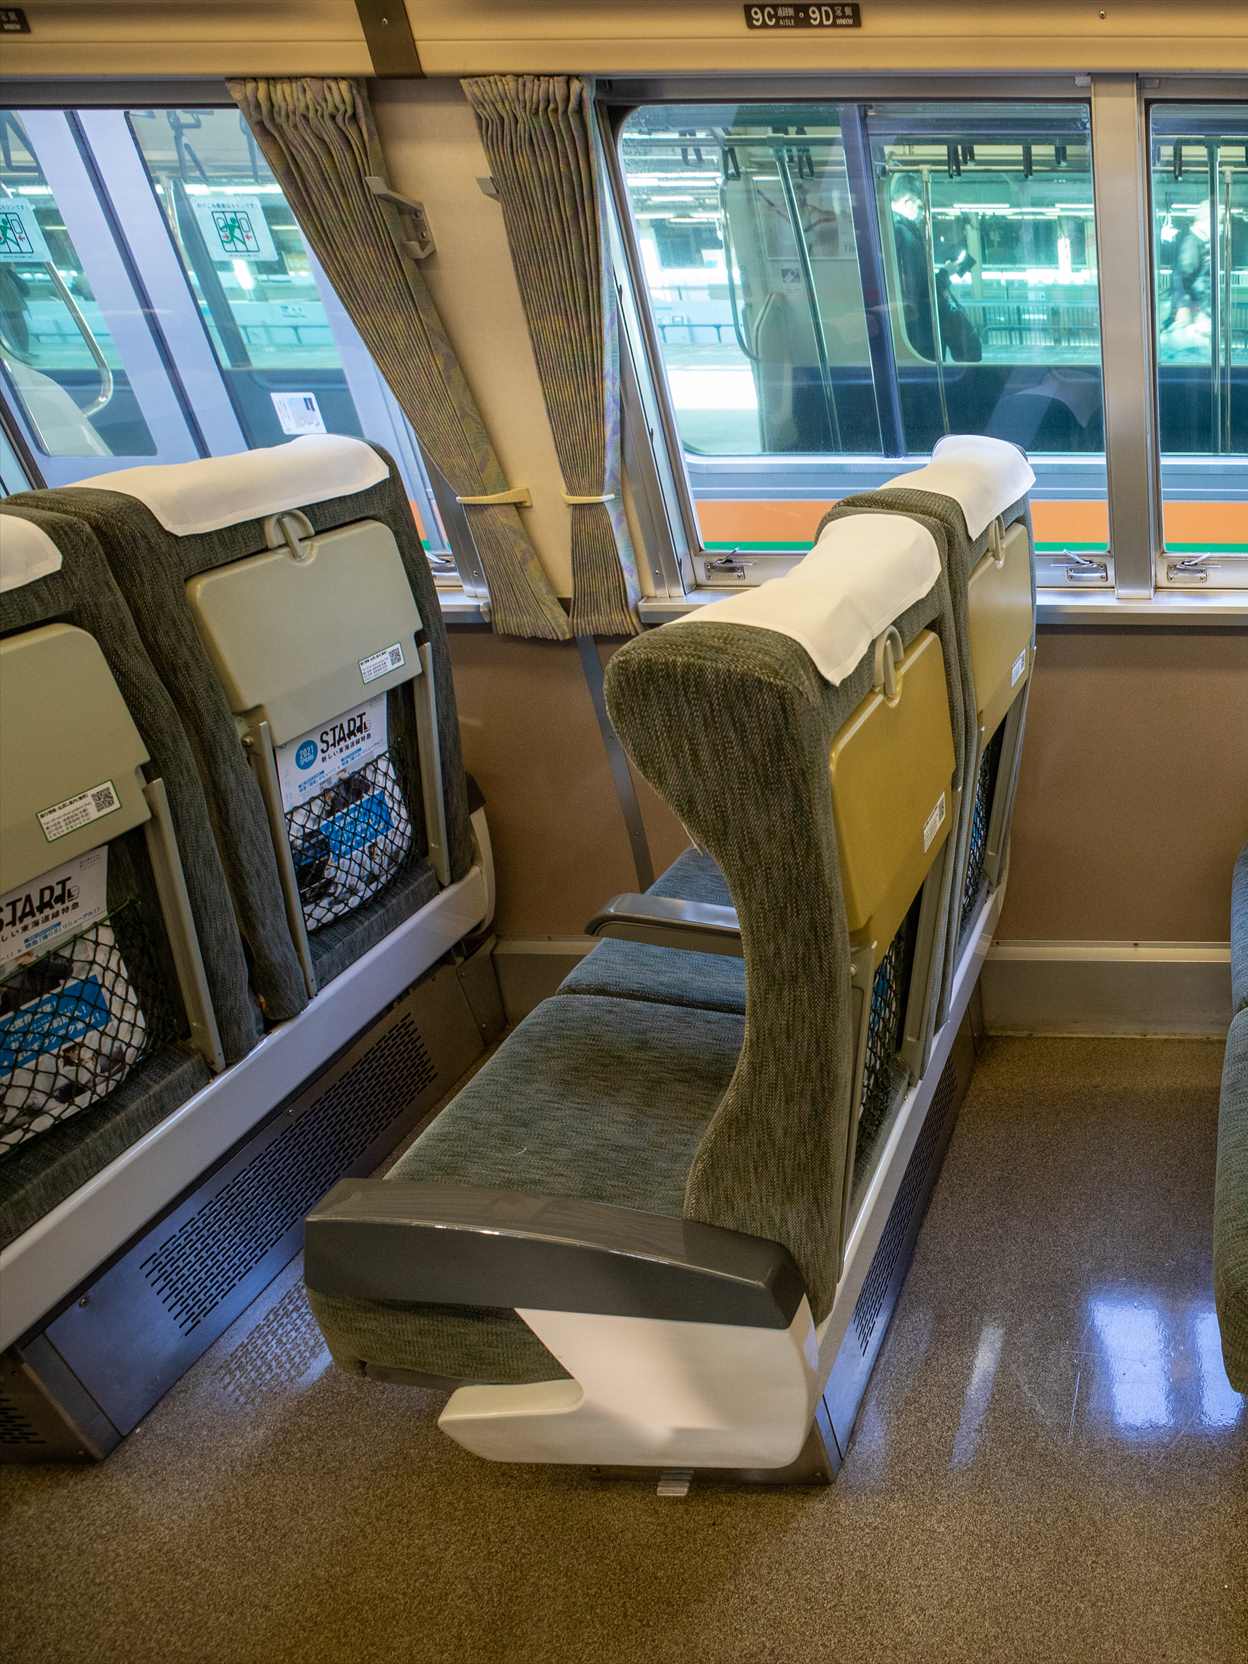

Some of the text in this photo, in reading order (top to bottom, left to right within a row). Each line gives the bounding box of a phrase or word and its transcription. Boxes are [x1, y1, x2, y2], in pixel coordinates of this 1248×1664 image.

[751, 7, 776, 26] 9C
[808, 6, 834, 25] 9D
[320, 711, 366, 754] START
[0, 876, 72, 932] TART
